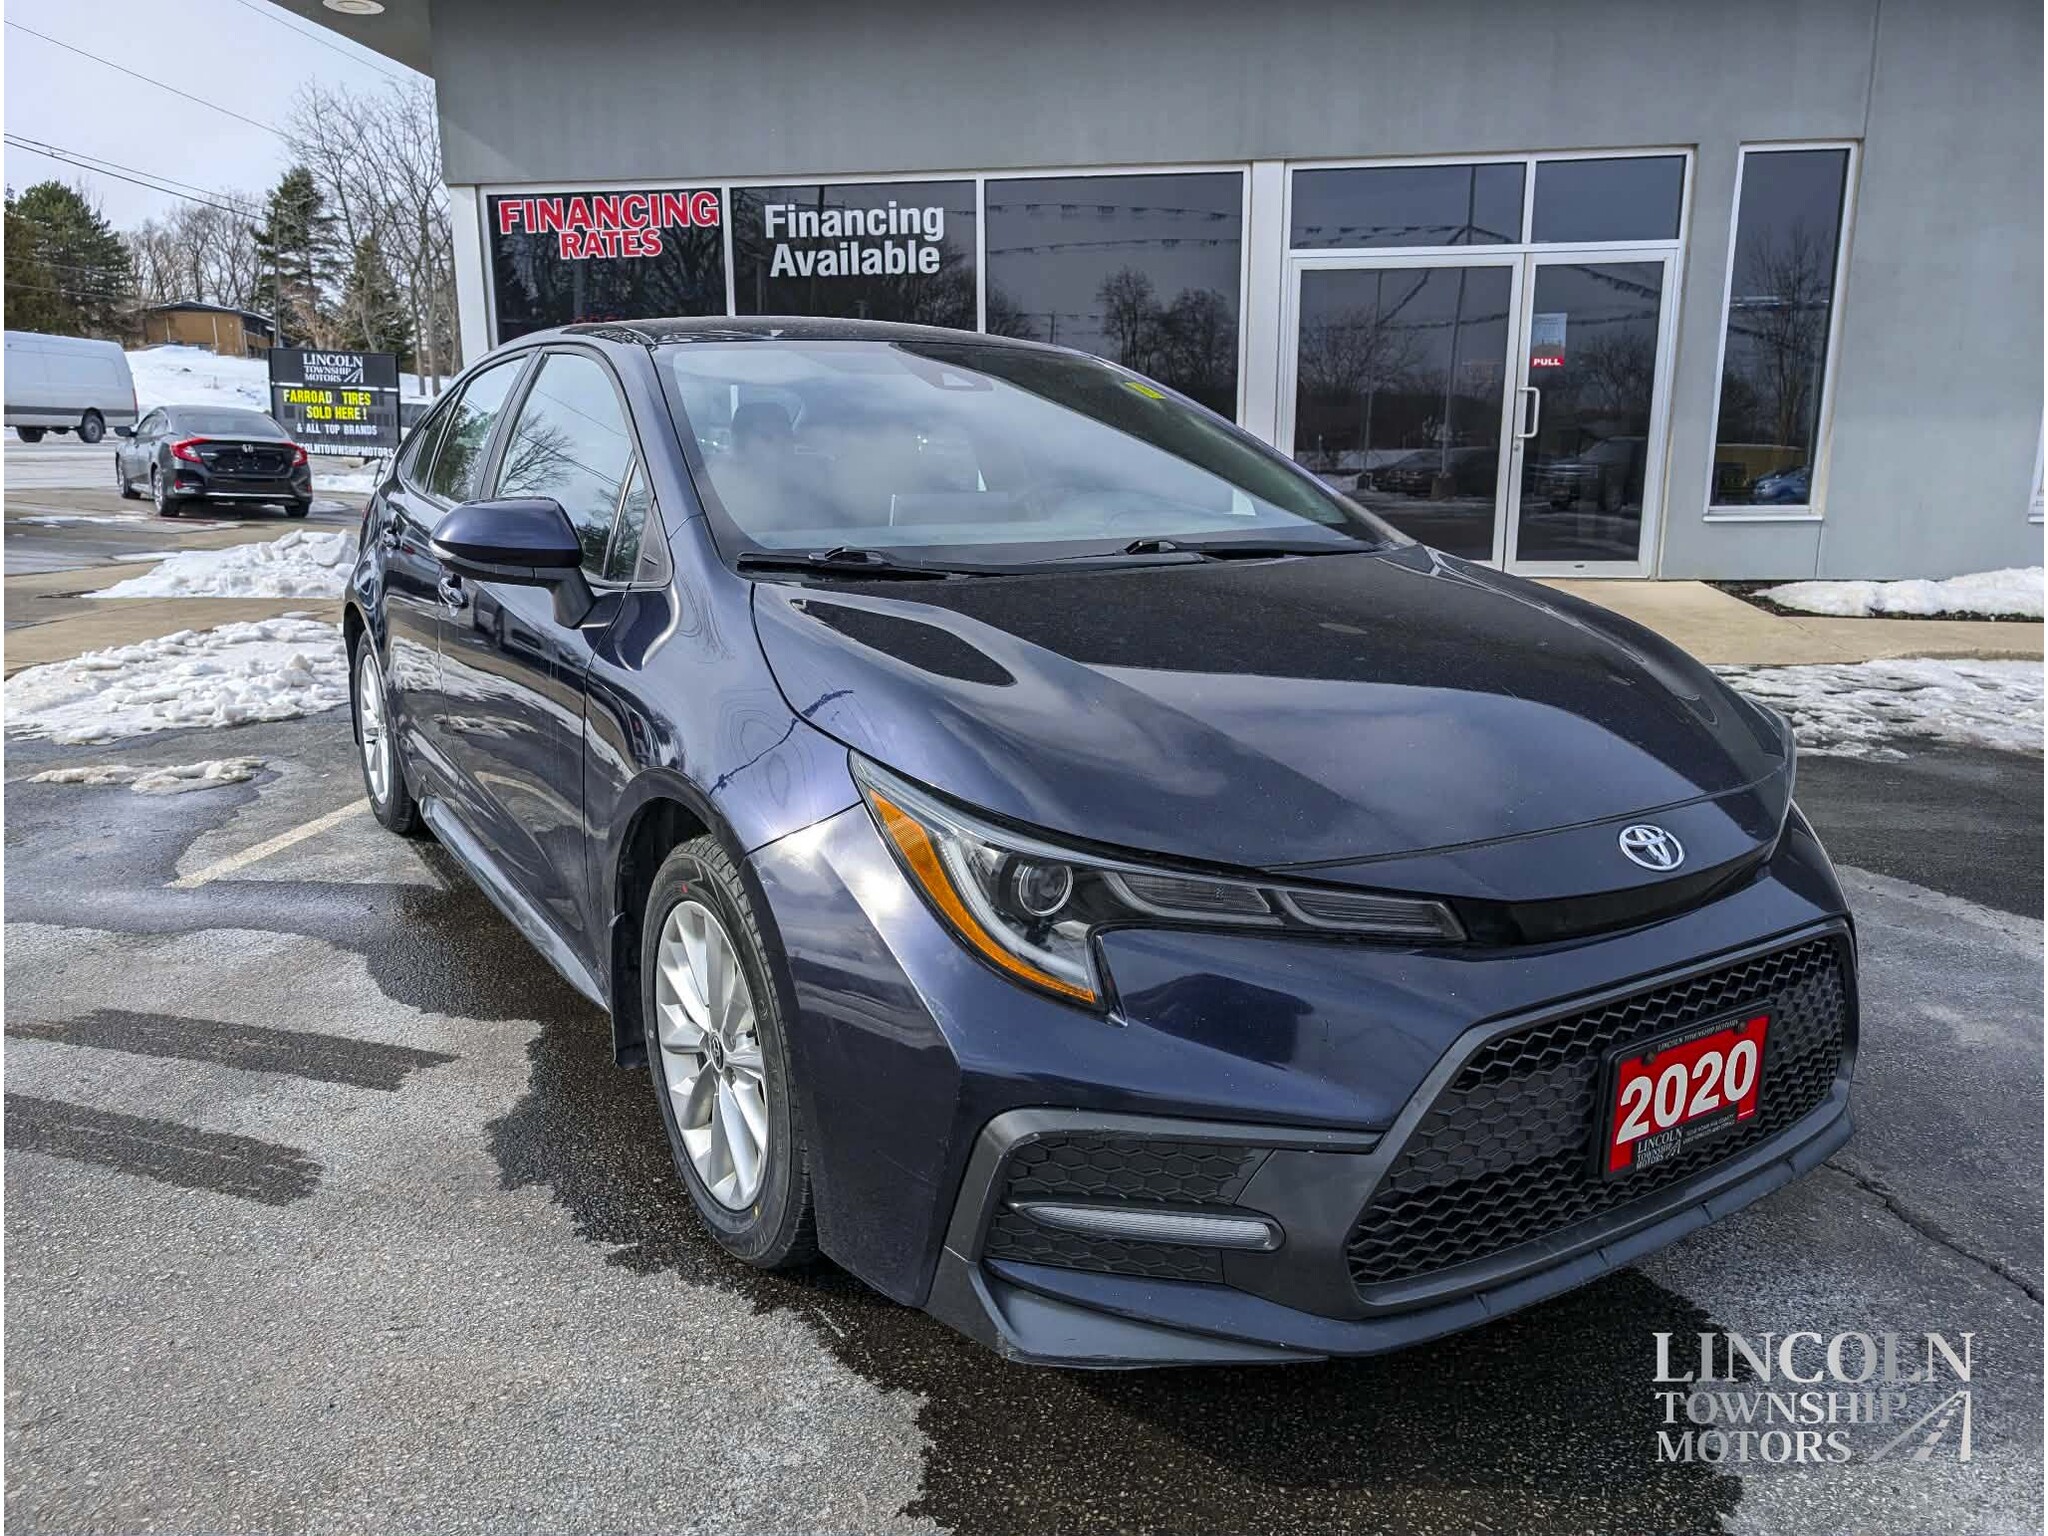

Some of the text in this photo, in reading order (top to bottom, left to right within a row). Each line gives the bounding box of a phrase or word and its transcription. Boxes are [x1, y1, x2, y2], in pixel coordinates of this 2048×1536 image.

[498, 191, 719, 234] FINANCING
[764, 201, 945, 242] Financing
[559, 229, 663, 260] RATES
[769, 239, 942, 278] Available
[303, 353, 363, 368] LINCOLN
[1533, 358, 1560, 366] PULL
[303, 365, 352, 375] TOWNSHIP
[304, 373, 342, 383] MOTORS
[283, 389, 371, 406] FARROAD TIRES
[306, 405, 332, 419] SOLD
[296, 422, 378, 435] & ALL TOP BRANDS
[1616, 1039, 1758, 1146] 2020
[1637, 1127, 1682, 1154] LINCOLN
